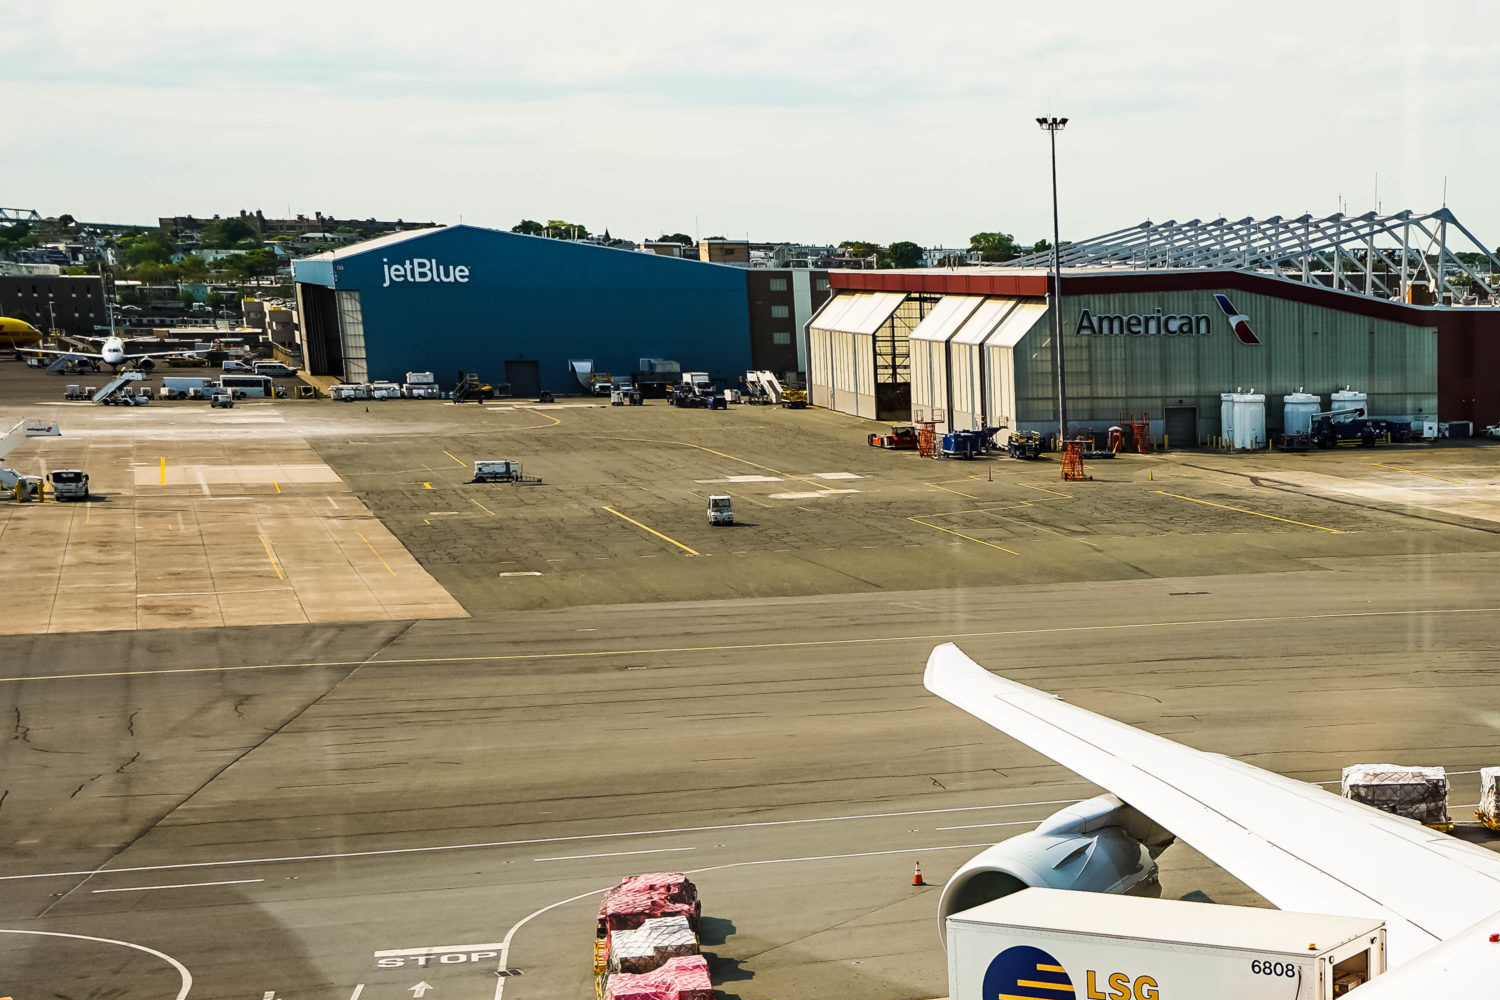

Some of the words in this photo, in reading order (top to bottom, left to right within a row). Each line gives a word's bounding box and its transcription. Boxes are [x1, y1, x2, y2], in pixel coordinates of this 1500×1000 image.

[382, 257, 469, 288] jetBlue
[1074, 307, 1212, 336] American
[377, 951, 498, 968] STOP
[1251, 959, 1296, 978] 6808
